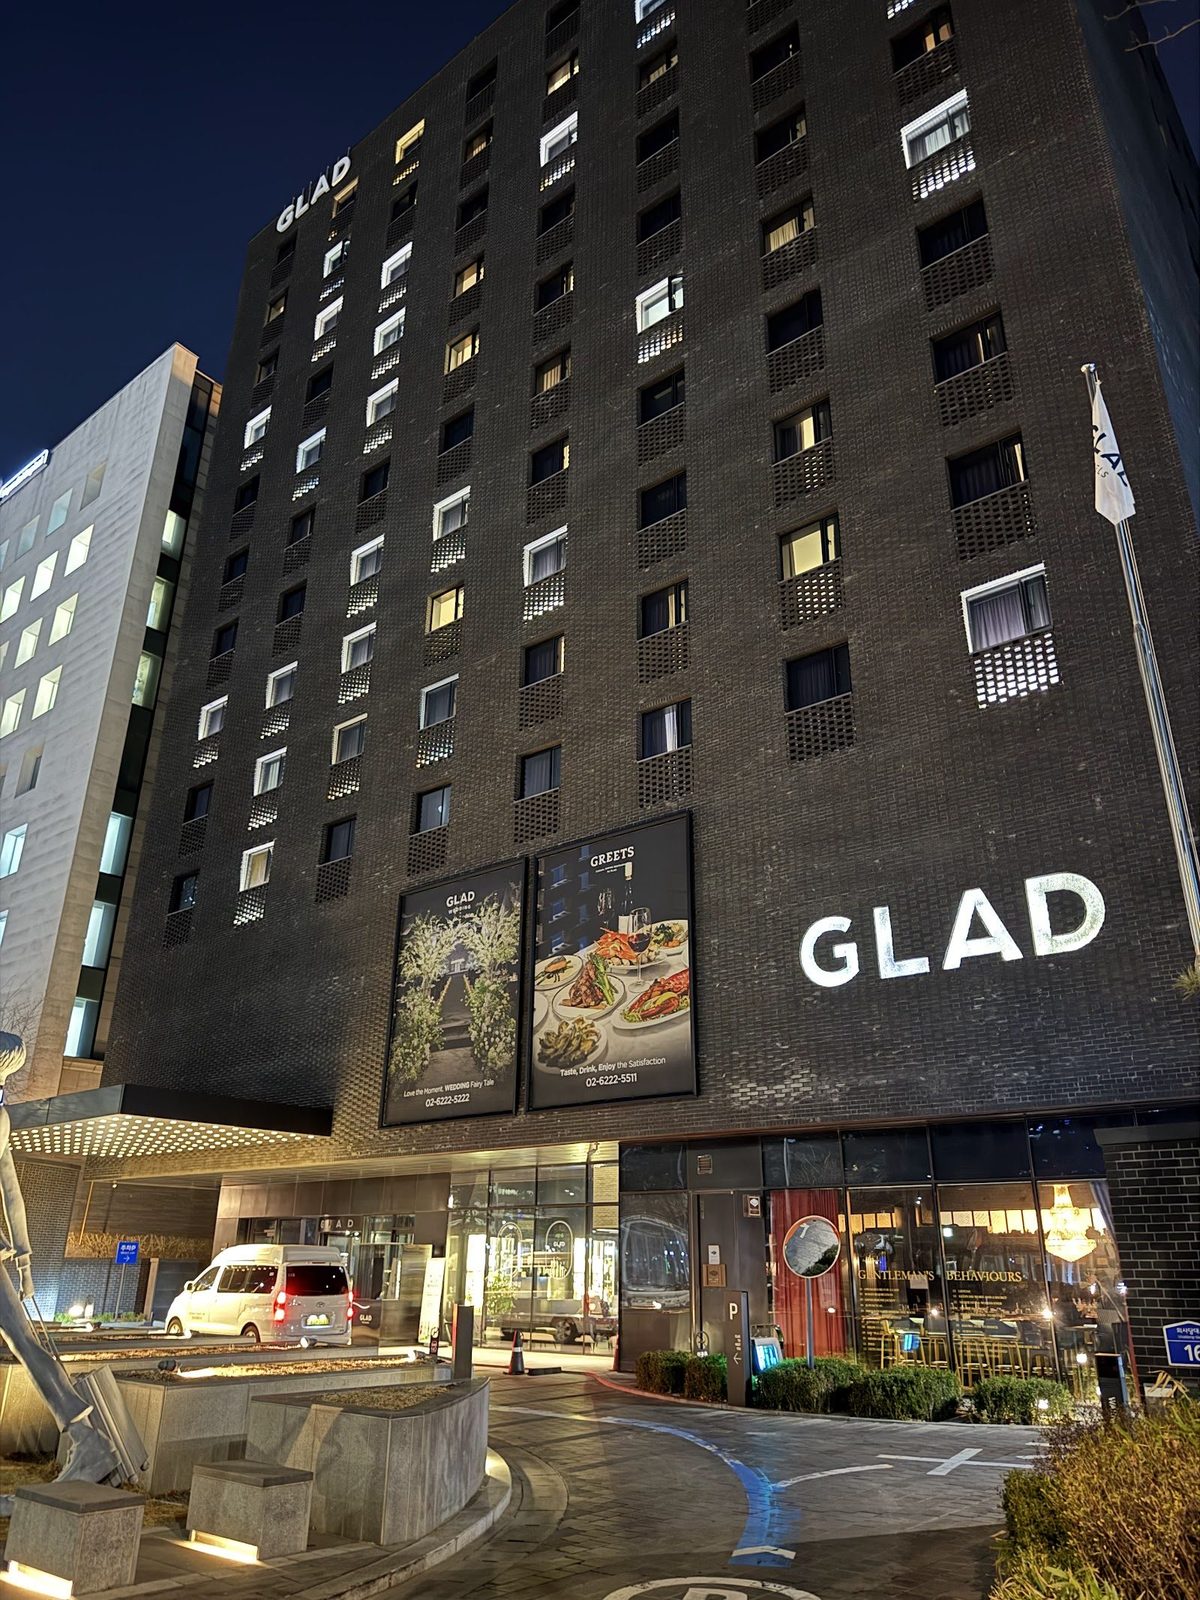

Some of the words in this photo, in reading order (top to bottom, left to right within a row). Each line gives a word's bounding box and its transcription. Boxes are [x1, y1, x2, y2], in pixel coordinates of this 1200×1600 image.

[276, 156, 351, 233] GLAD
[590, 846, 635, 867] GREETS
[446, 891, 475, 907] GLAD
[800, 872, 1106, 988] GLAD
[560, 1069, 578, 1077] Taste,
[579, 1066, 598, 1075] Drink,
[598, 1063, 616, 1072] Enjoy
[617, 1061, 628, 1069] the
[628, 1057, 666, 1068] Satisfaction
[403, 1090, 415, 1098] Love
[415, 1088, 424, 1096] the
[444, 1081, 470, 1092] WEDDING
[470, 1080, 483, 1089] Fairy
[483, 1079, 495, 1087] Tale
[585, 1073, 638, 1088] 02-6222-5511
[858, 1269, 935, 1280] GENTLEMAN'S
[946, 1270, 1022, 1282] BEHAVIOURS
[729, 1303, 738, 1320] P
